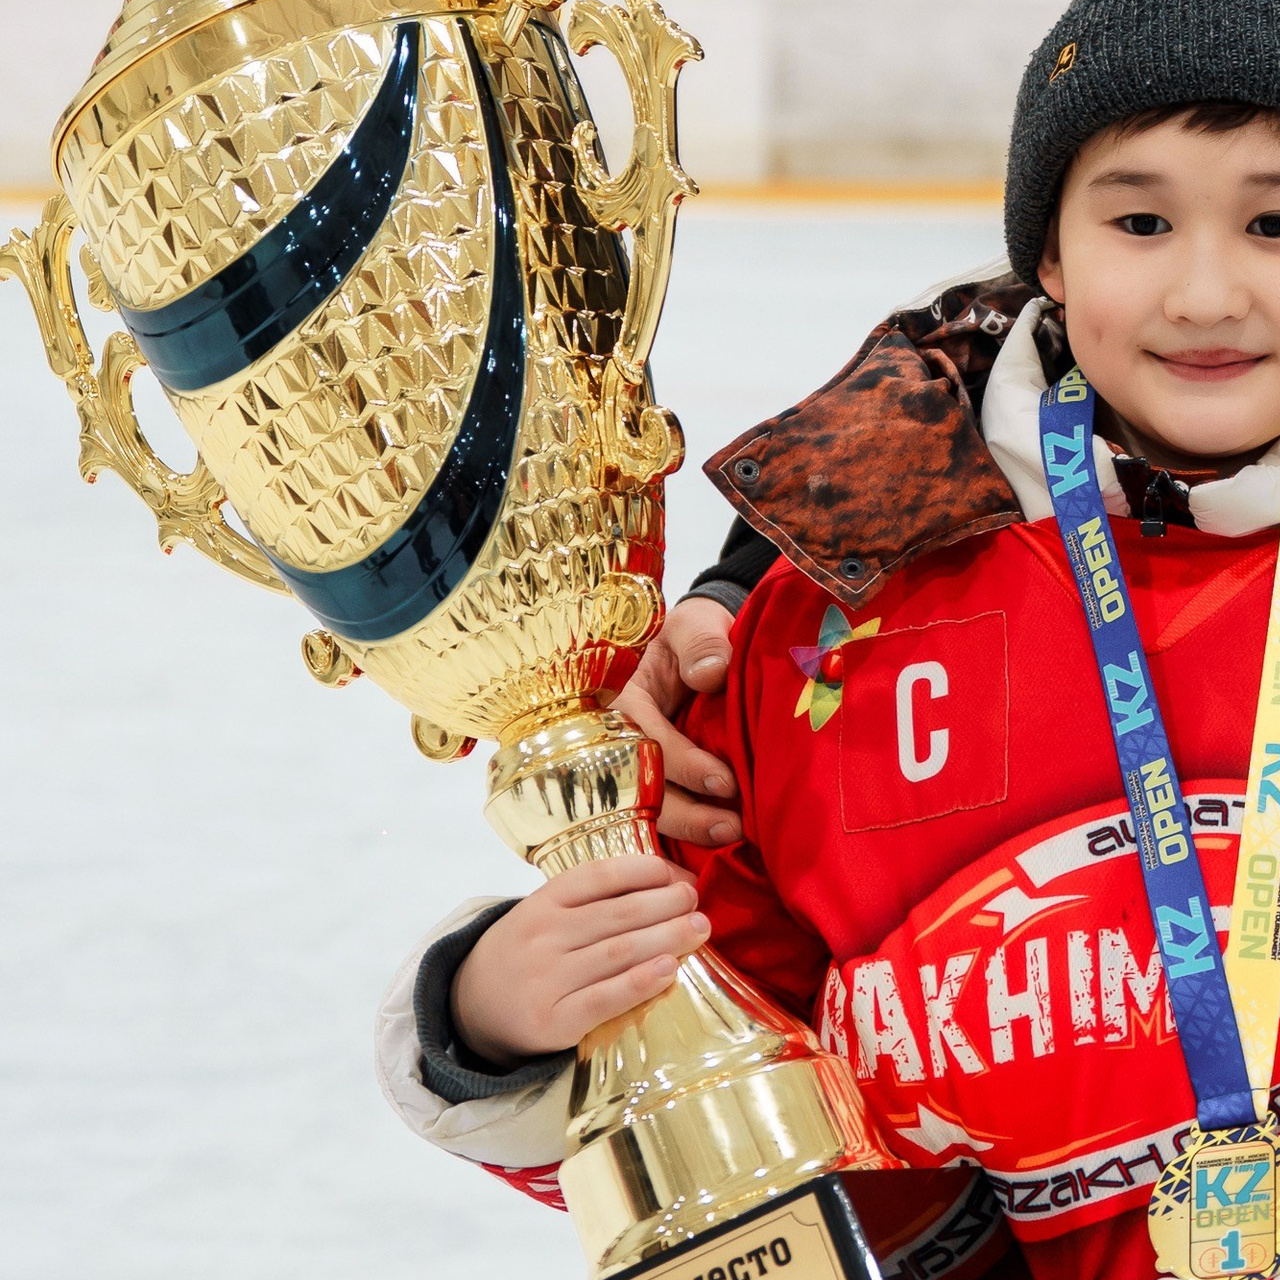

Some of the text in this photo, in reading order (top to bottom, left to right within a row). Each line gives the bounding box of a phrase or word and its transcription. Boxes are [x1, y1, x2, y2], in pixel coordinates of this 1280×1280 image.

[1043, 424, 1090, 498] KZ
[1078, 516, 1126, 624] OPEN
[896, 660, 949, 783] C
[1103, 650, 1155, 736] KZ
[1126, 771, 1138, 803] HOCKEY
[1140, 757, 1189, 866] OPEN
[1139, 821, 1152, 872] KAZAKHSTAN
[1155, 896, 1216, 980] KZ
[1238, 854, 1278, 961] OPEN
[1271, 910, 1280, 961] TOURNAMENT
[1196, 1162, 1271, 1210] KZ
[1196, 1202, 1270, 1229] OPEN
[1221, 1230, 1246, 1271] 1
